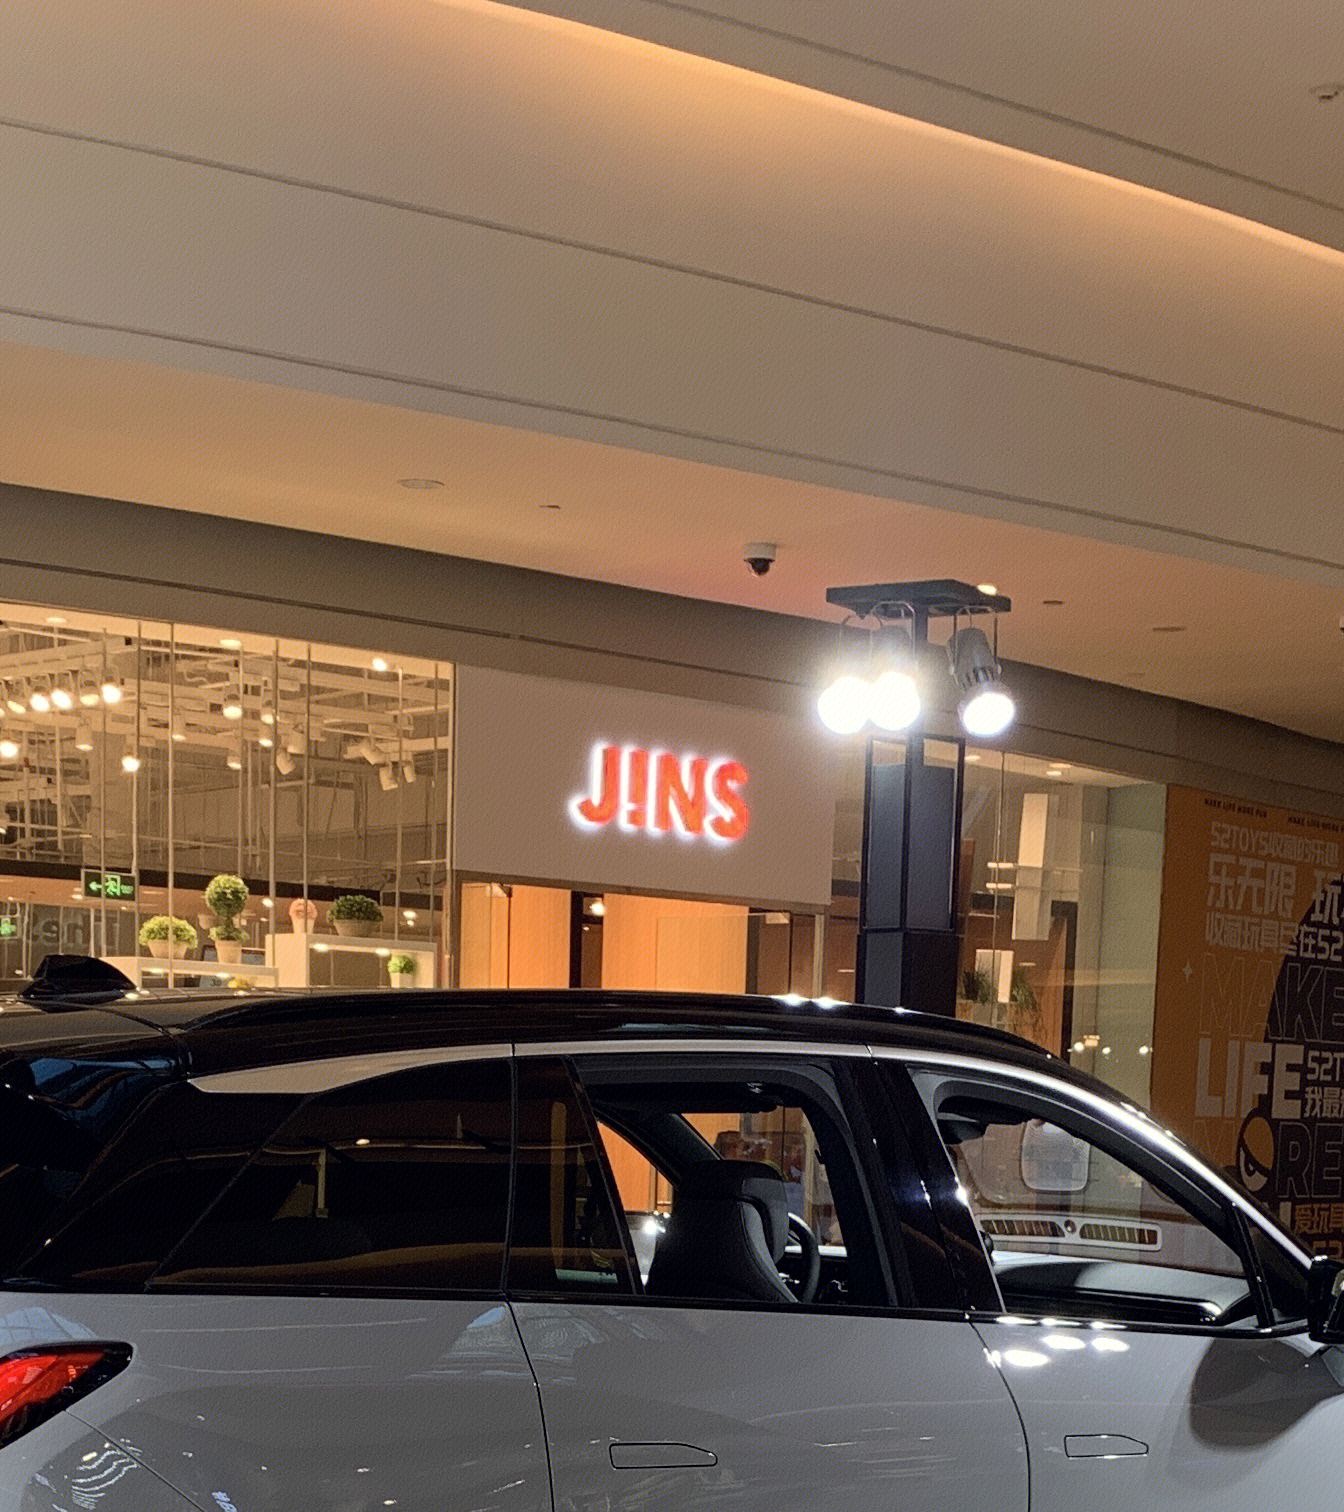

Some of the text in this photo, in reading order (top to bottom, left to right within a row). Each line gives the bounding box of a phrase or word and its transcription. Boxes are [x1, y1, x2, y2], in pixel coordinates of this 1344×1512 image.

[573, 745, 750, 842] JINS
[1205, 852, 1298, 920] 乐无限
[1194, 1036, 1305, 1120] LIFE
